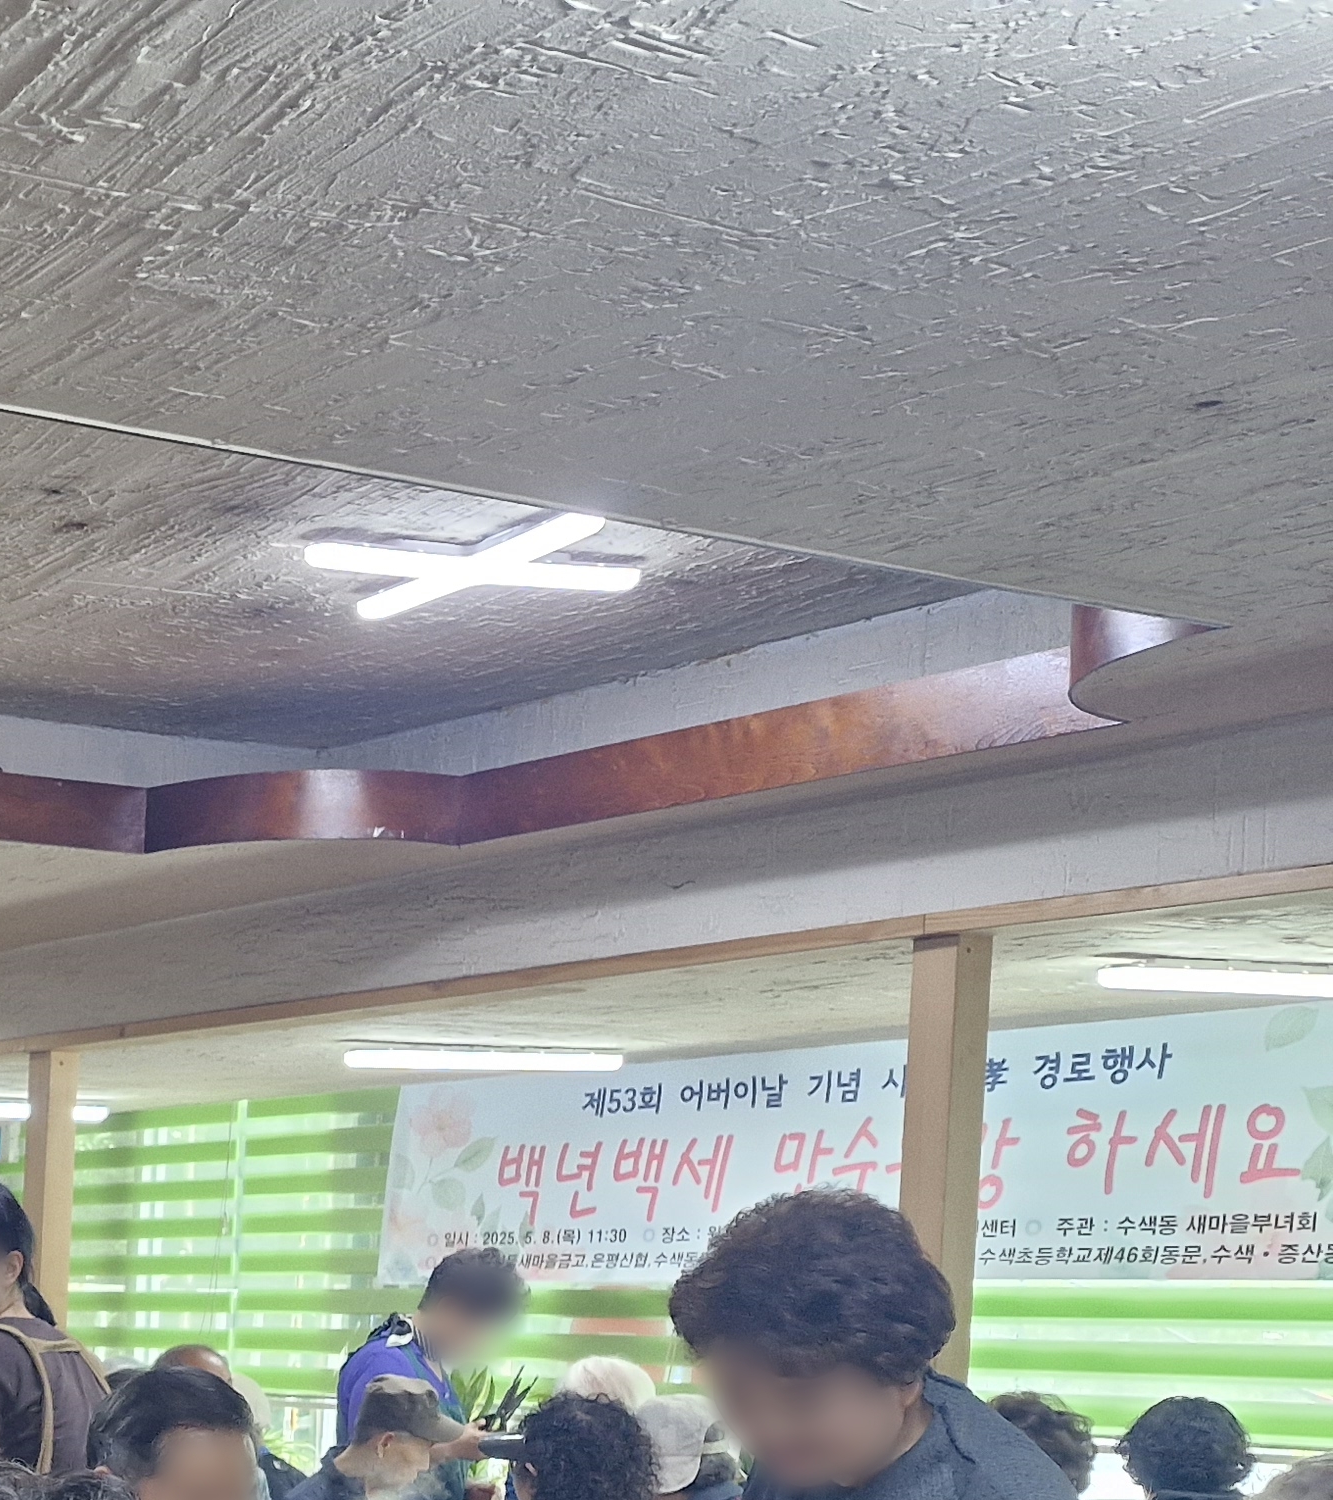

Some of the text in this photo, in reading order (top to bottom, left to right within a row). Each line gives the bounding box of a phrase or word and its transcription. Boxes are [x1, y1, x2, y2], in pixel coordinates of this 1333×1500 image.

[582, 1083, 663, 1117] 제53회
[680, 1073, 788, 1111] 어버이날
[807, 1067, 862, 1103] 기념
[1033, 1042, 1173, 1090] 경로행사
[498, 1134, 735, 1227] 백년백세
[1066, 1103, 1301, 1199] 하세요
[444, 1231, 469, 1248] 일시
[483, 1231, 519, 1246] 2025.
[588, 1228, 627, 1244] 11:30
[661, 1226, 691, 1244] 장소
[1056, 1216, 1095, 1237] 주관
[1116, 1215, 1178, 1236] 수색동
[1186, 1211, 1318, 1235] 새마을부녀회
